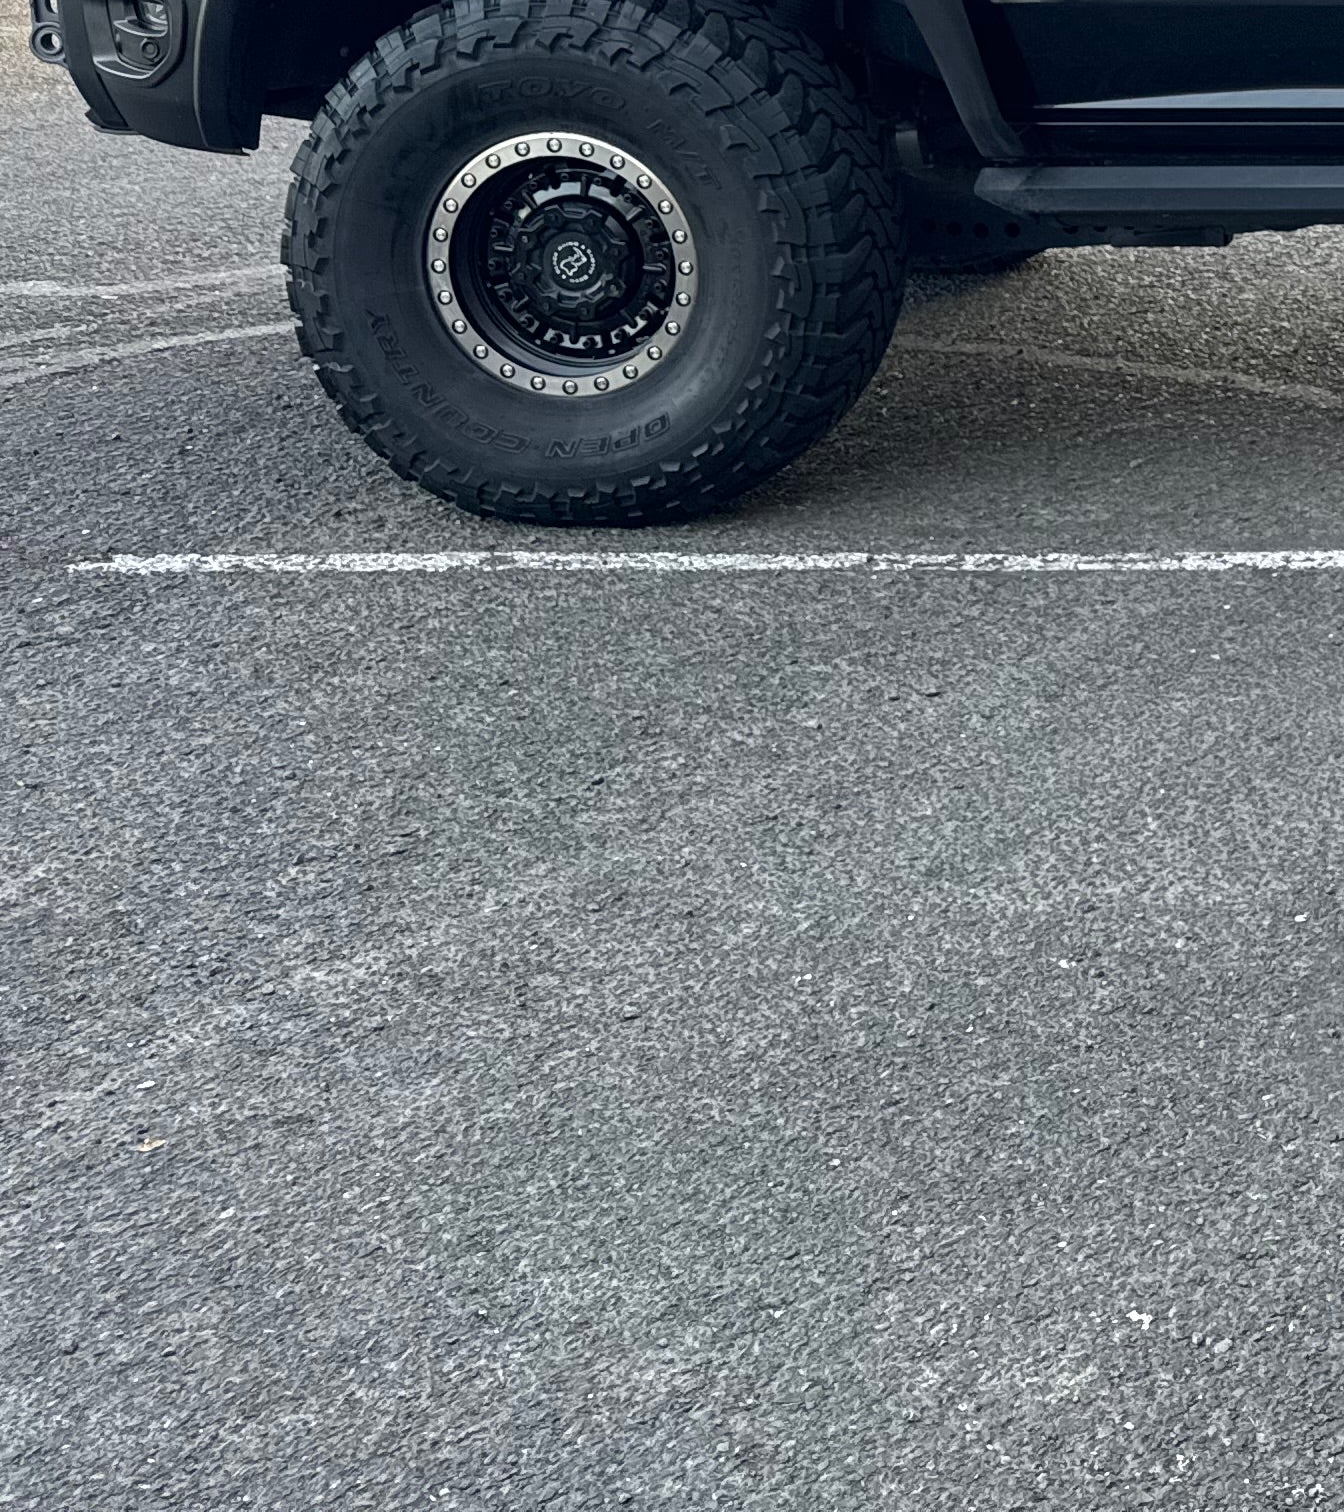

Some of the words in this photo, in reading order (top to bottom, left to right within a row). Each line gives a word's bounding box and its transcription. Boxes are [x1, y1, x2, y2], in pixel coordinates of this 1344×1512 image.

[477, 75, 626, 110] TOYO
[363, 308, 530, 455] COUNTRY
[545, 411, 671, 458] OPEN
